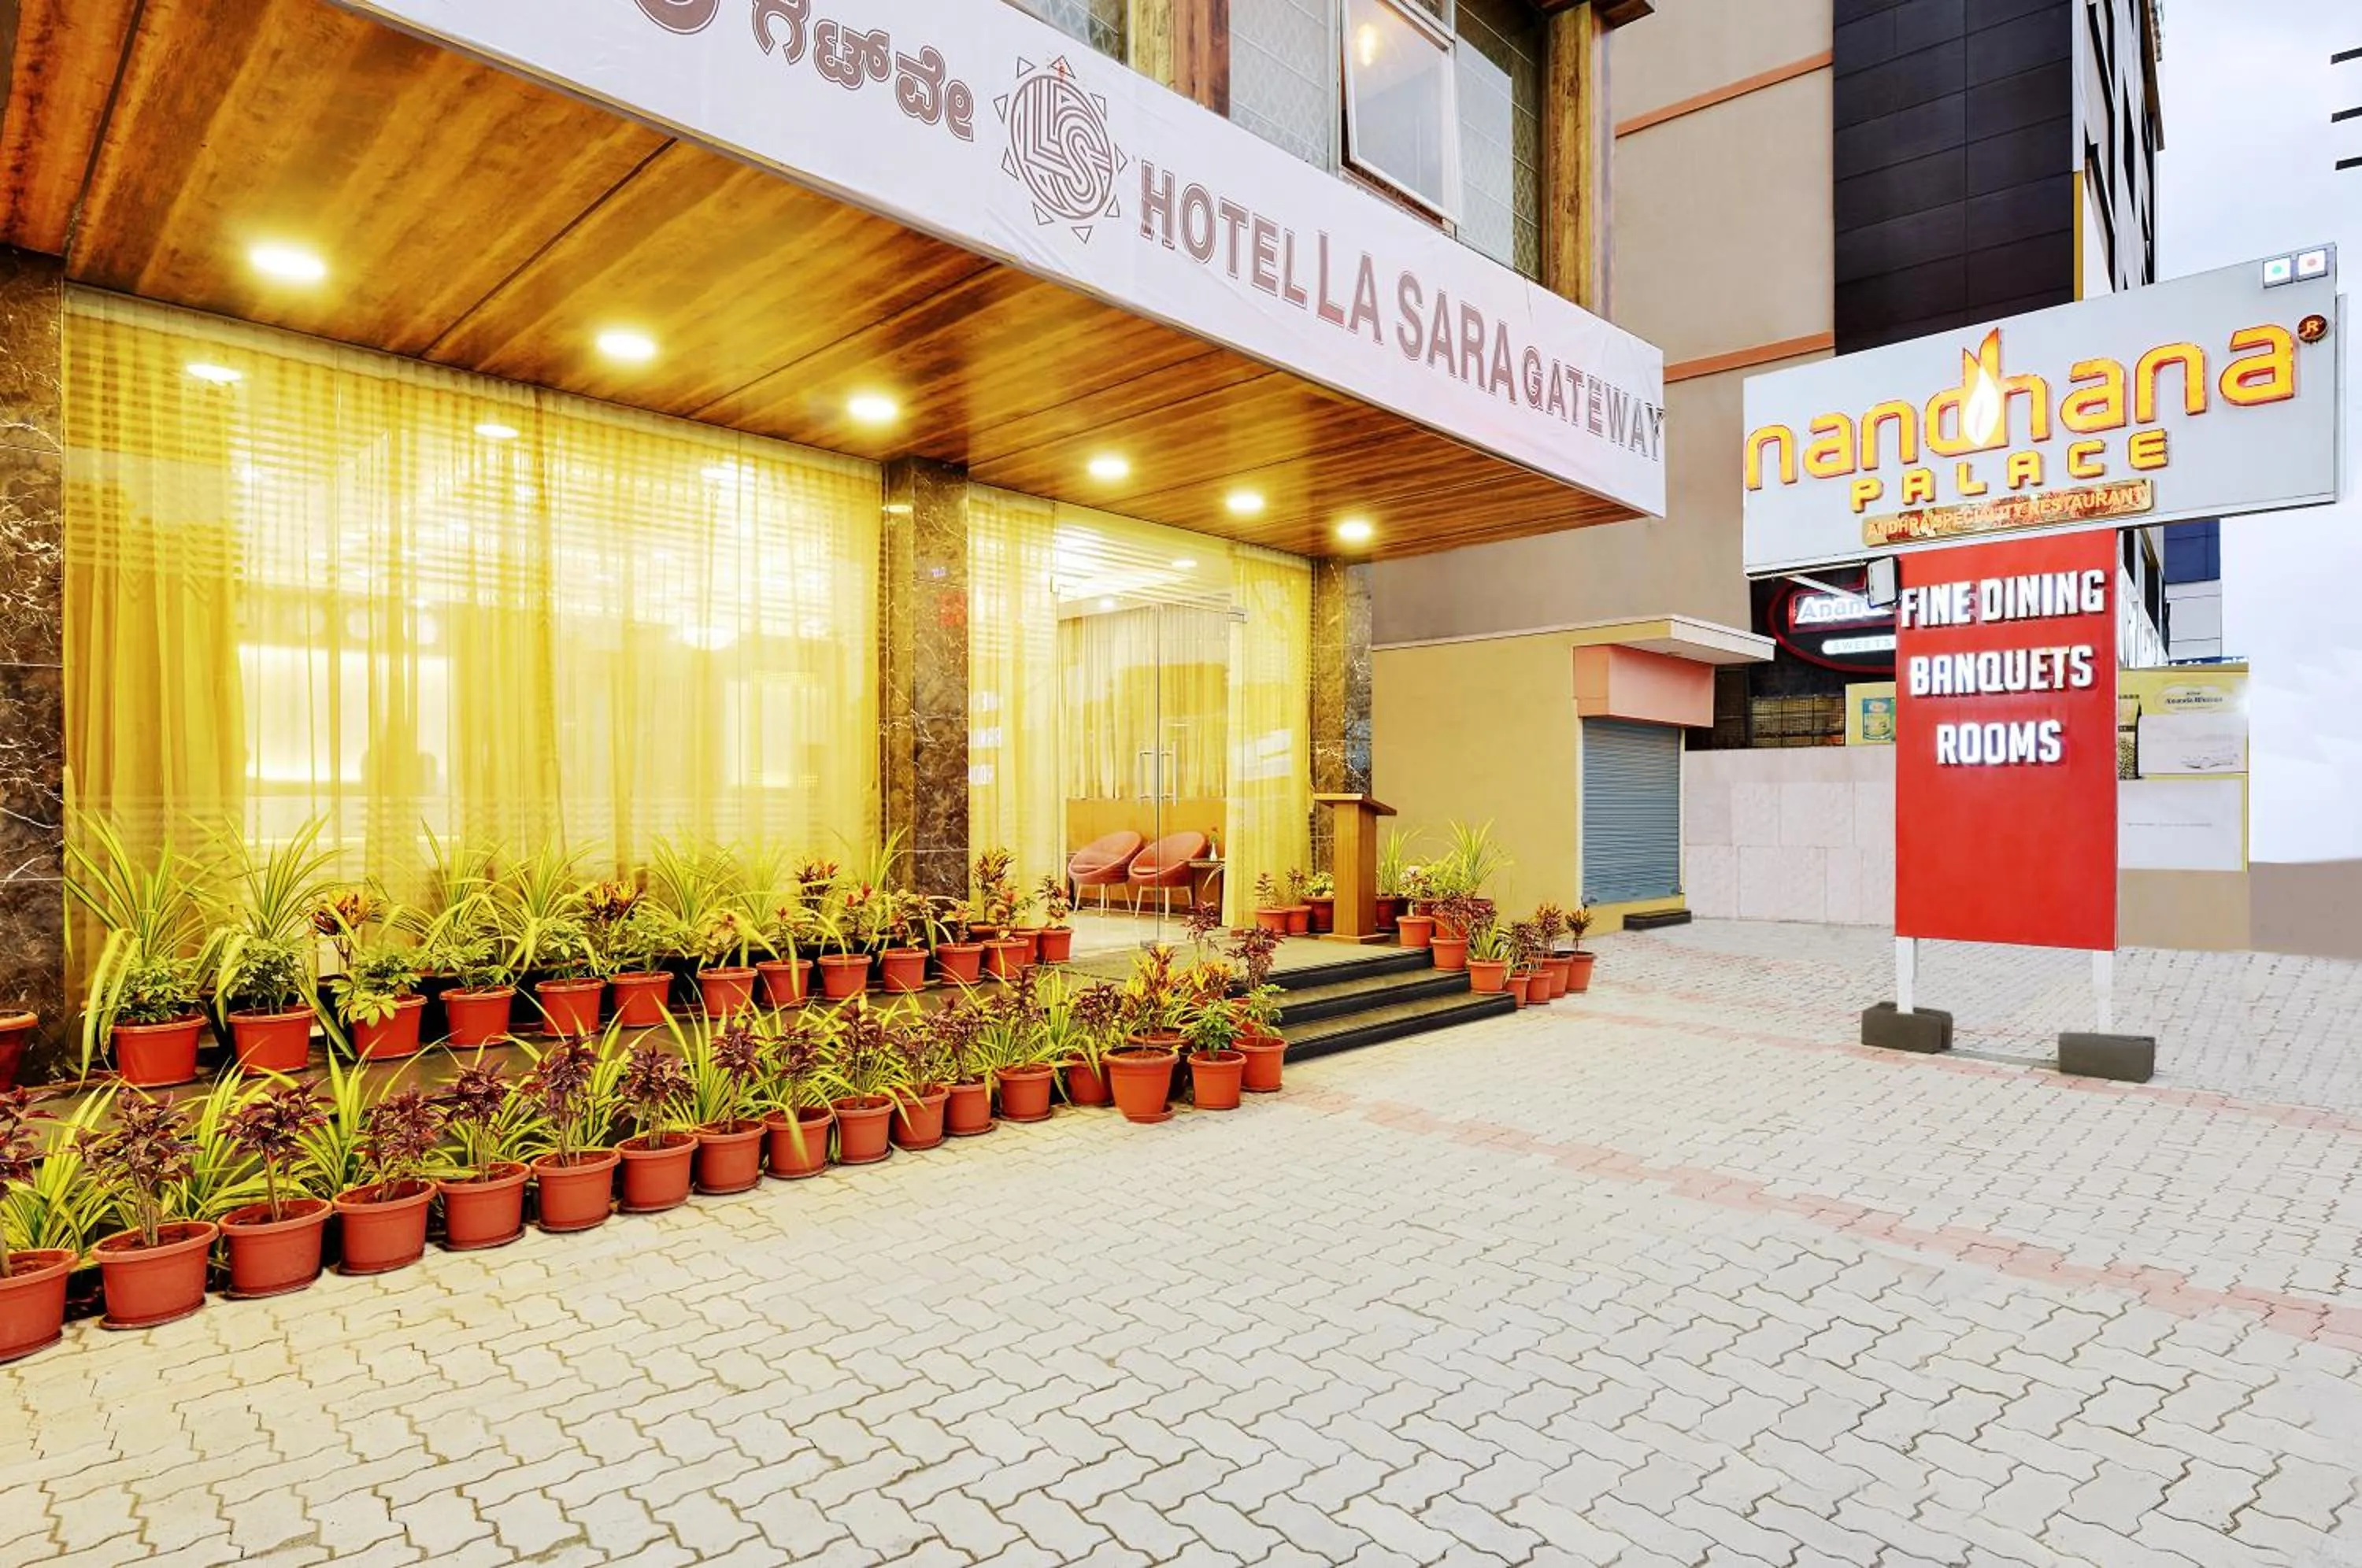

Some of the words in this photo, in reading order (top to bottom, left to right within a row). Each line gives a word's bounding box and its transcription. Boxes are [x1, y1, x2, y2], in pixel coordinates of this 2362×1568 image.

[1141, 159, 1307, 310] HOTEL
[1316, 229, 1384, 346] LA
[1396, 270, 1517, 405] SARA
[1523, 346, 1664, 462] GATEWAY
[1746, 327, 2295, 490] nandhana
[1851, 428, 2168, 513] PALACE
[1797, 595, 1874, 624] Anan
[1901, 582, 1975, 627] FINE
[1981, 570, 2104, 622] DINING
[1832, 638, 1893, 651] SWEETS
[1910, 645, 2094, 697] BANQUETS
[1937, 719, 2062, 764] ROOMS
